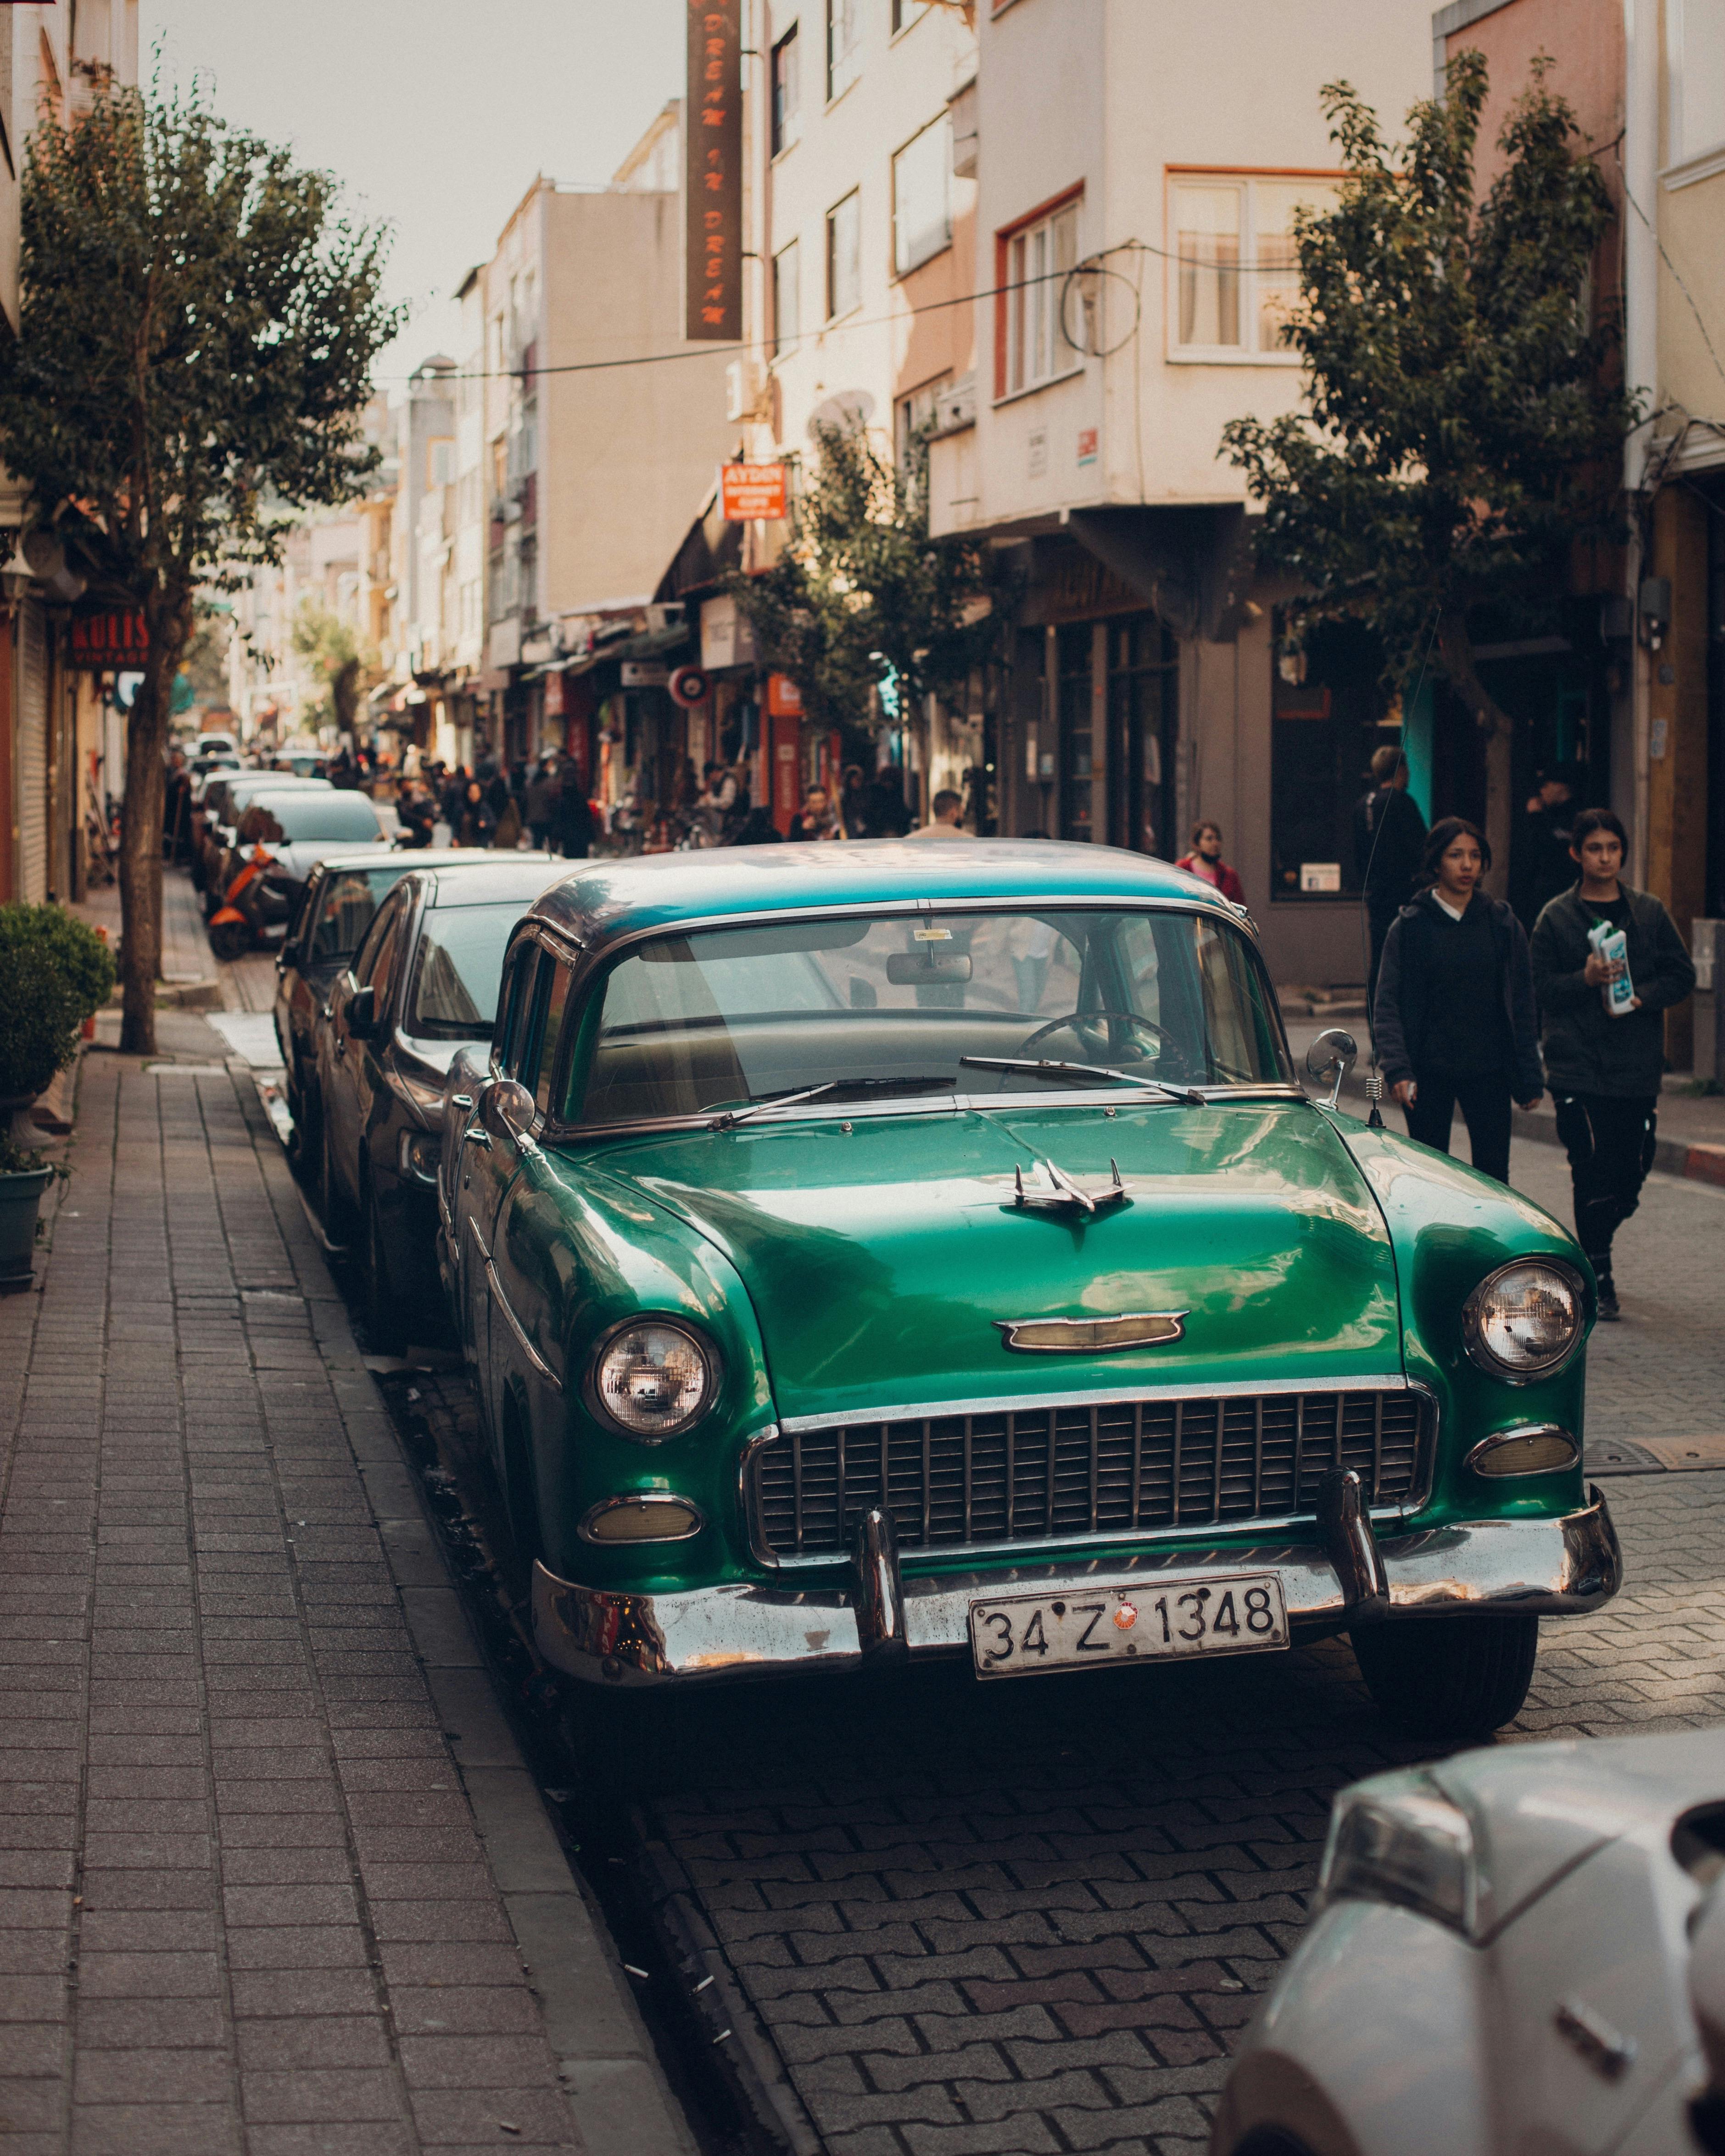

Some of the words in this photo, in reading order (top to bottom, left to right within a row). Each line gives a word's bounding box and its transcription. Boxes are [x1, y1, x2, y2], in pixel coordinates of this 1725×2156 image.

[701, 13, 726, 127] DREAM
[701, 210, 727, 325] DREAM
[983, 1608, 1049, 1661] 34
[1072, 1603, 1112, 1652] Z
[1154, 1587, 1274, 1643] 1348
